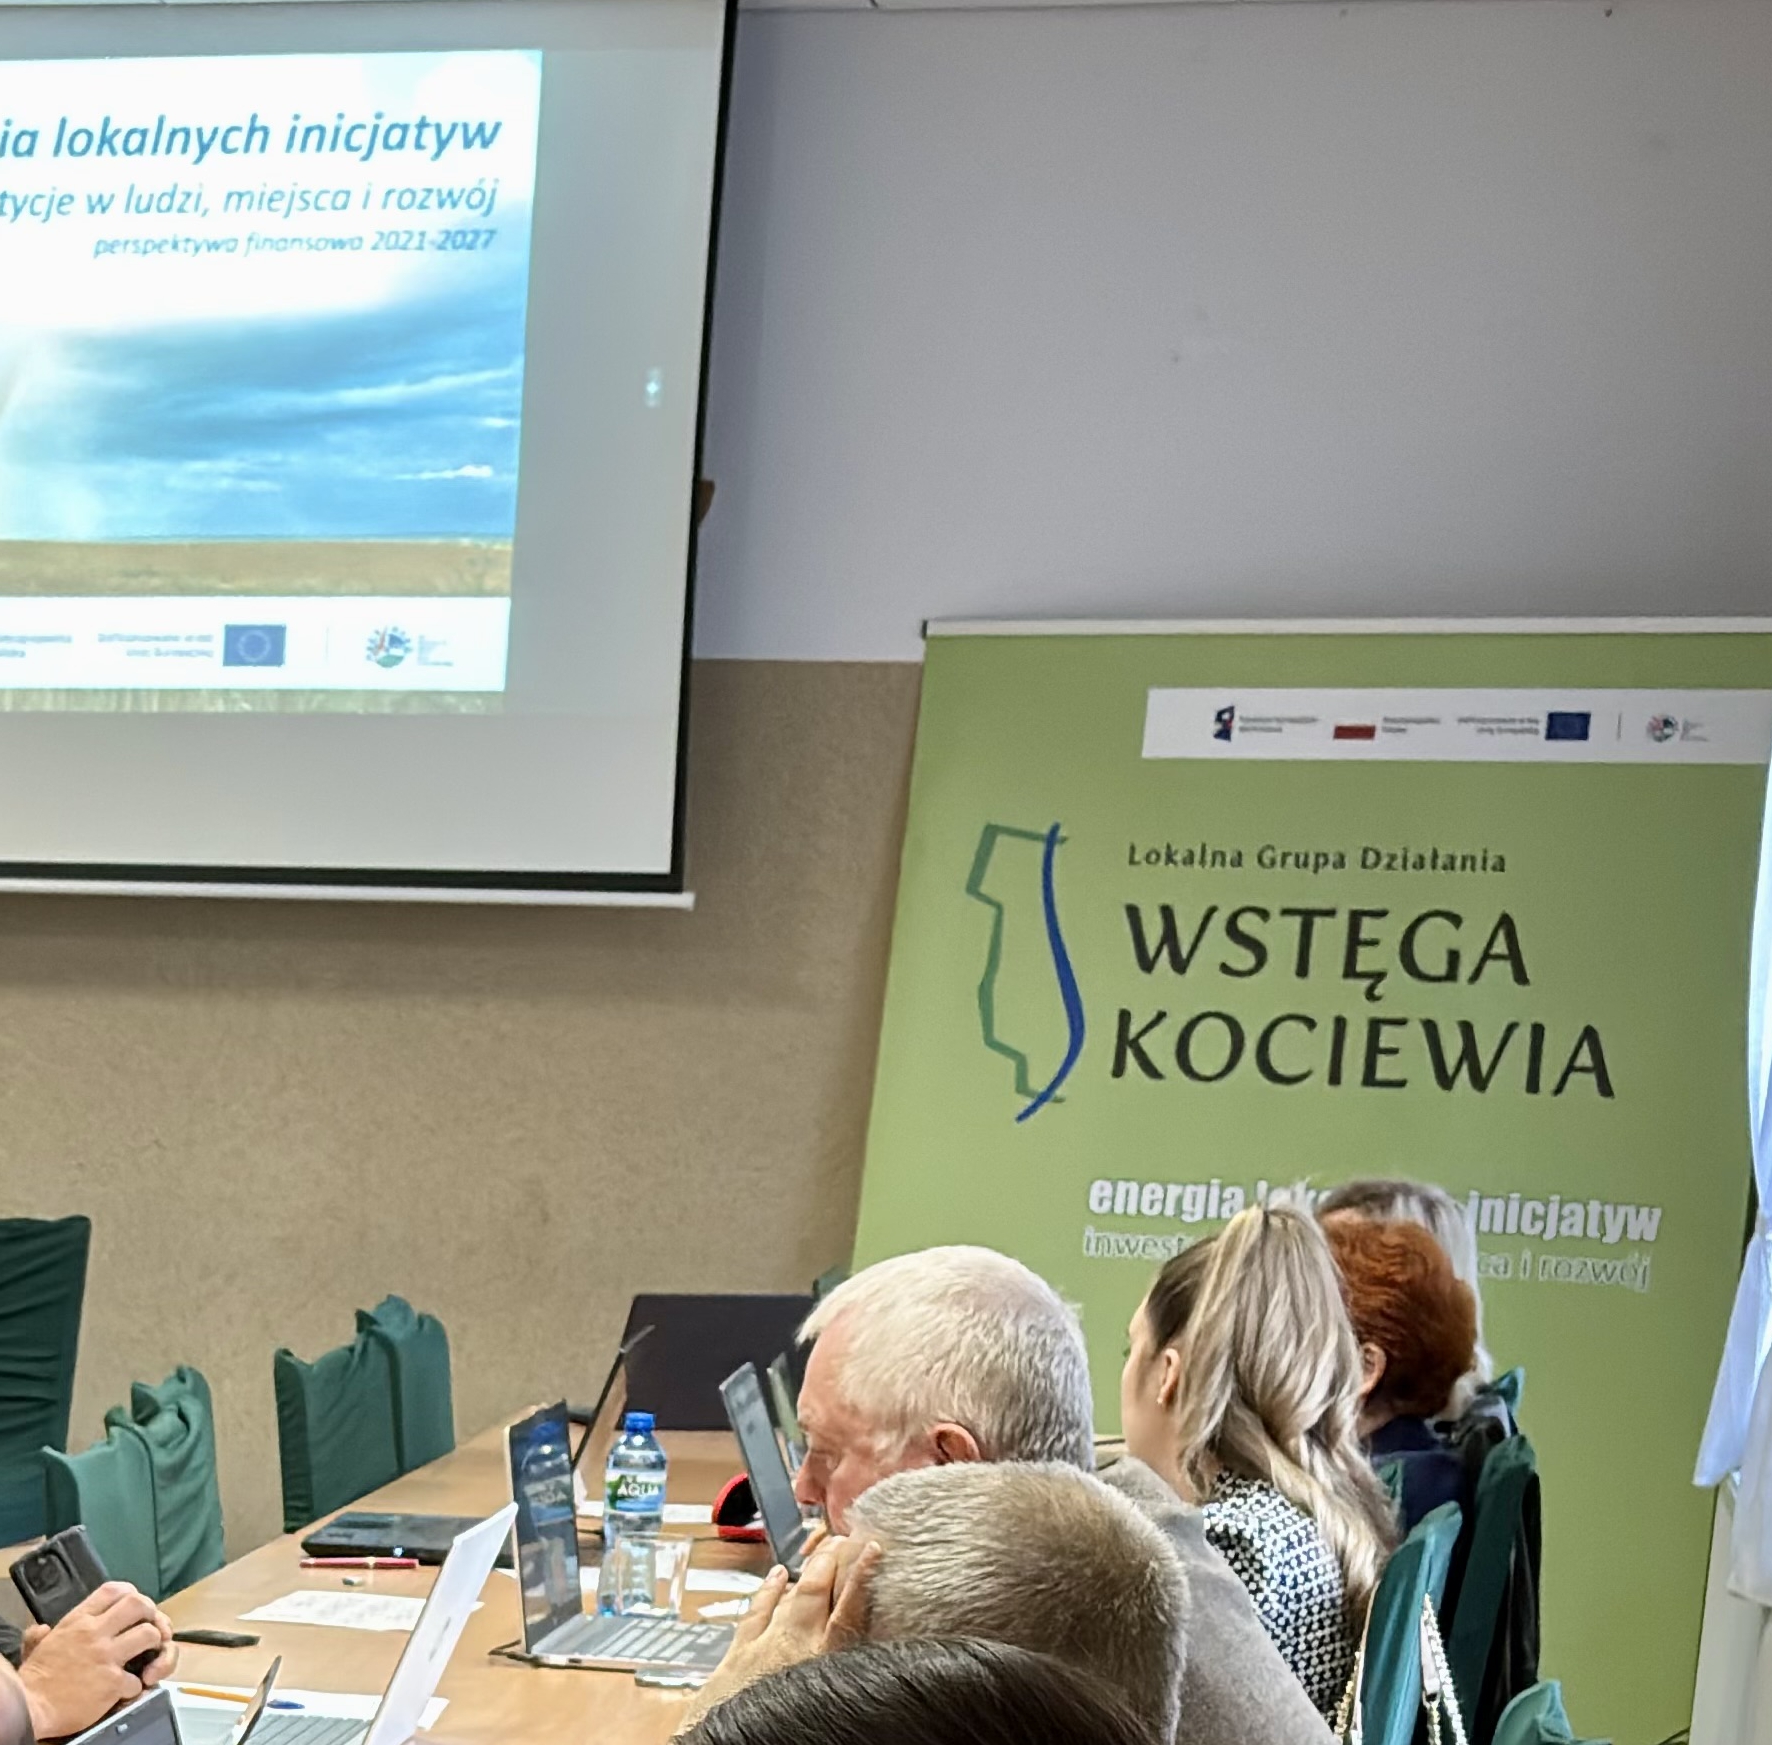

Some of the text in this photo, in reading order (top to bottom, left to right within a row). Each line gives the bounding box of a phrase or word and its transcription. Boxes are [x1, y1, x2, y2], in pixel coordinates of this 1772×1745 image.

[53, 112, 270, 164] lokalnych
[284, 112, 502, 162] inicjatyw
[85, 193, 116, 215] w
[123, 181, 210, 219] ludzi,
[222, 183, 352, 218] miejsca
[361, 183, 375, 211] i
[380, 178, 501, 217] rozwój
[94, 227, 497, 258] perspektywa finansowa 2021-2027
[1127, 841, 1508, 876] Lokalna Grupa Działania
[1124, 902, 1532, 1002] WSTĘGA
[1110, 1007, 1617, 1100] KOCIEWIA
[1088, 1178, 1245, 1223] energia
[1520, 1248, 1533, 1281] i
[617, 1481, 660, 1498] AQUA
